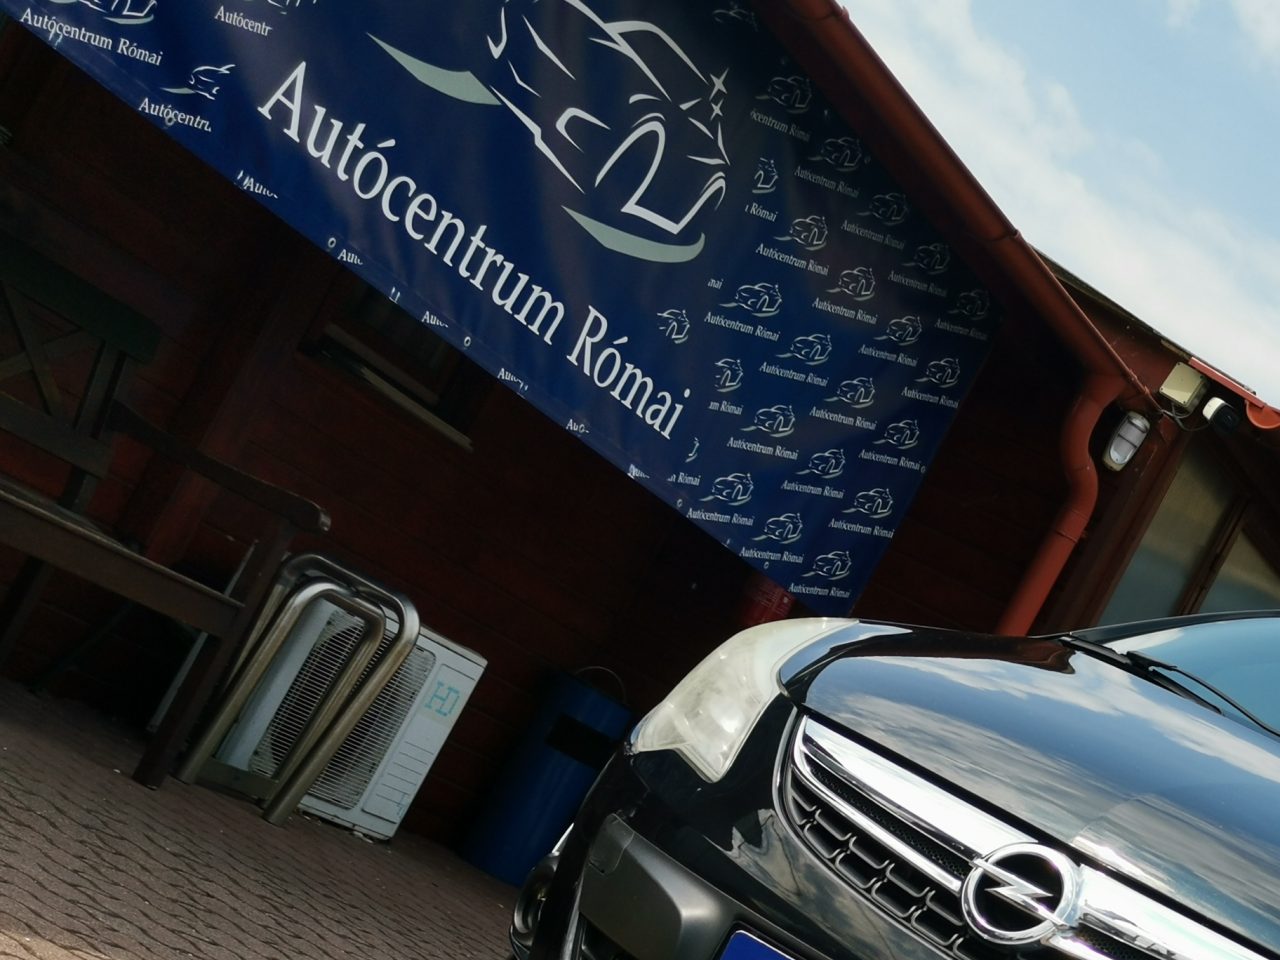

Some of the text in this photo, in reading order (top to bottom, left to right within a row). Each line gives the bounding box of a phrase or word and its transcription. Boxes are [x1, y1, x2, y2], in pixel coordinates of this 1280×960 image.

[20, 7, 164, 66] Autócentrum Római
[749, 202, 779, 222] Római
[257, 60, 692, 441] Autócentrum Római
[704, 312, 754, 334] Autócentrum
